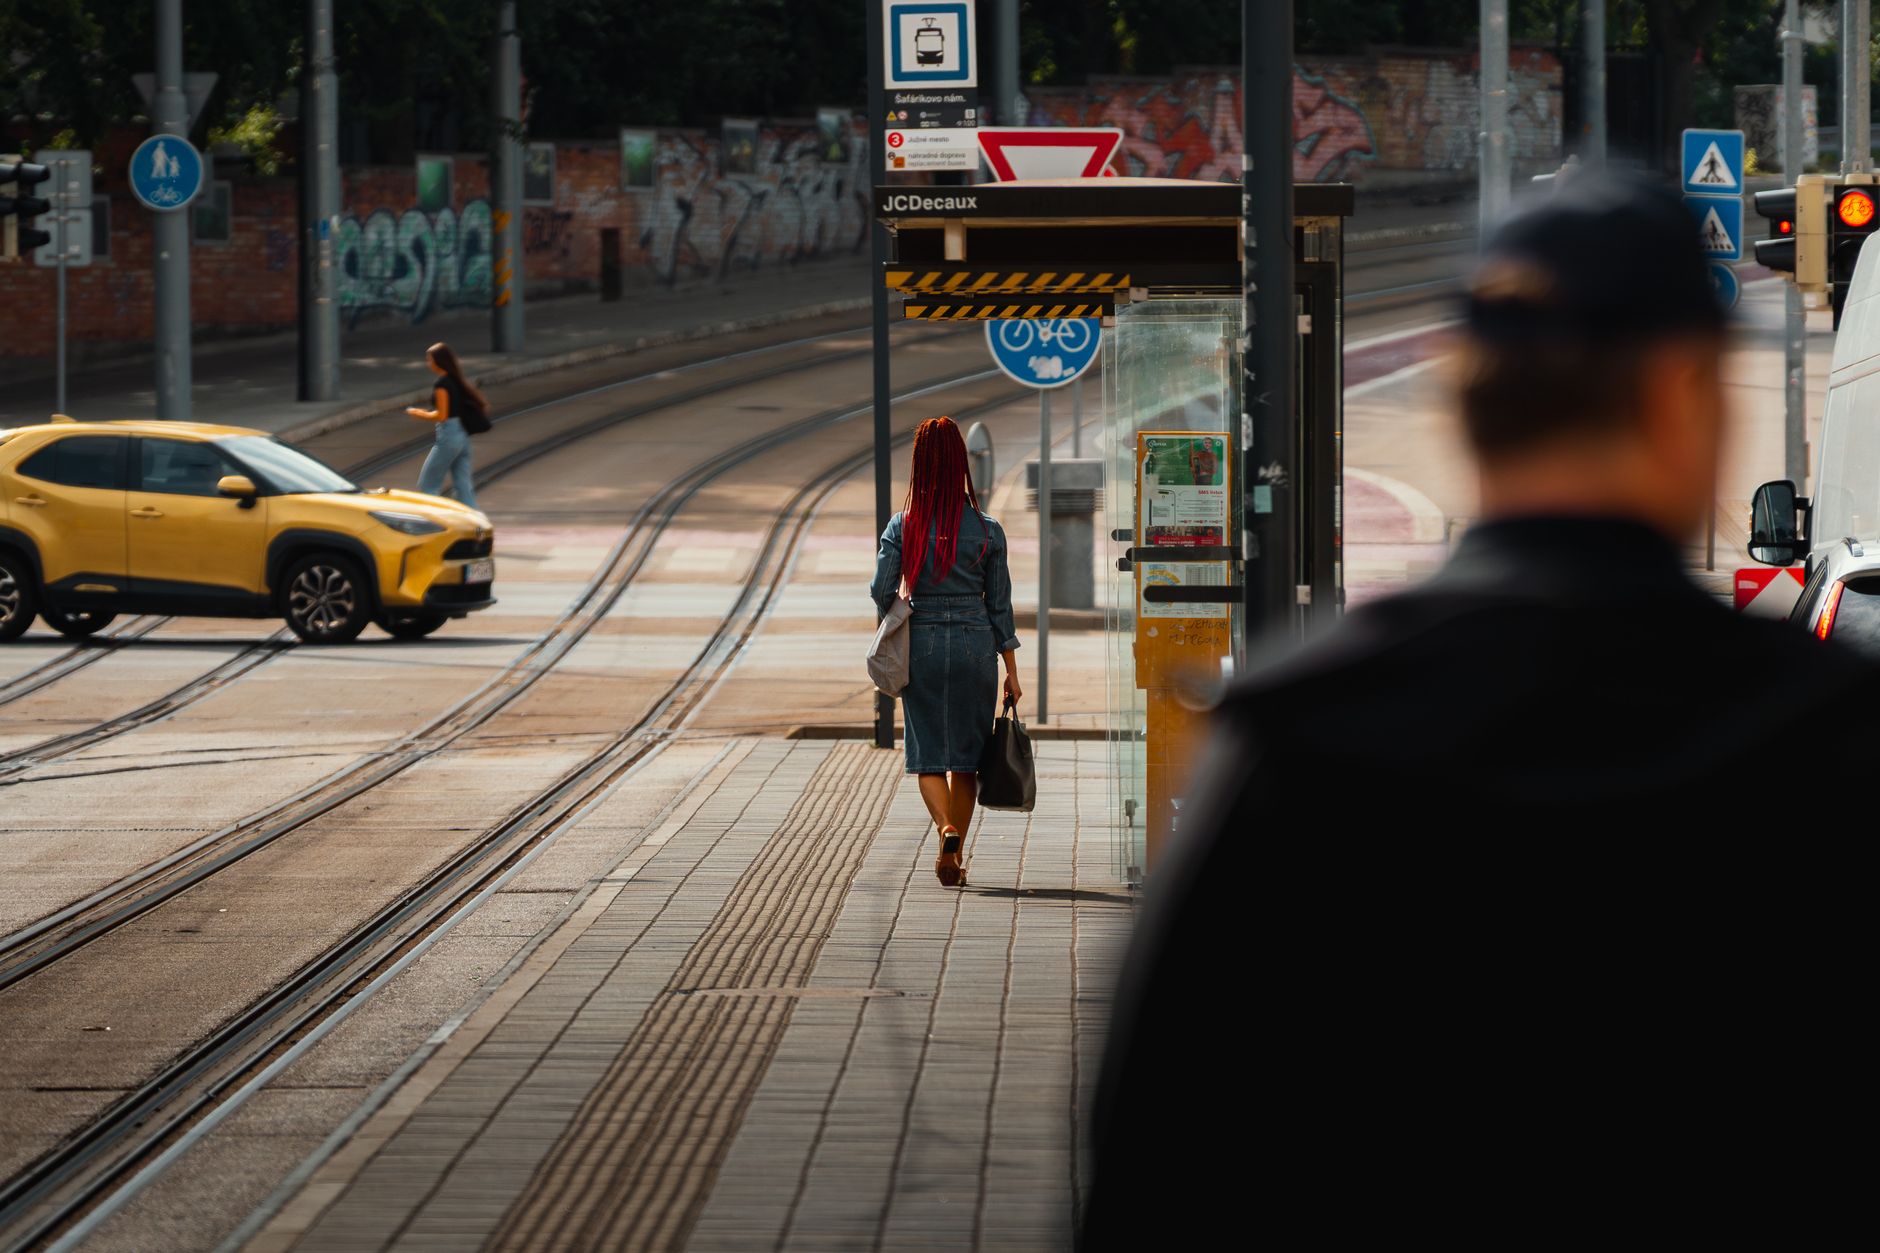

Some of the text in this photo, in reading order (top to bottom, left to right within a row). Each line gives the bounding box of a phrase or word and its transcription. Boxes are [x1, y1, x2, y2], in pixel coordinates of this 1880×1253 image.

[895, 93, 967, 103] Šafárikovo nám.
[891, 133, 900, 146] 3
[940, 151, 966, 159] doprava
[882, 195, 978, 211] JCDecaux
